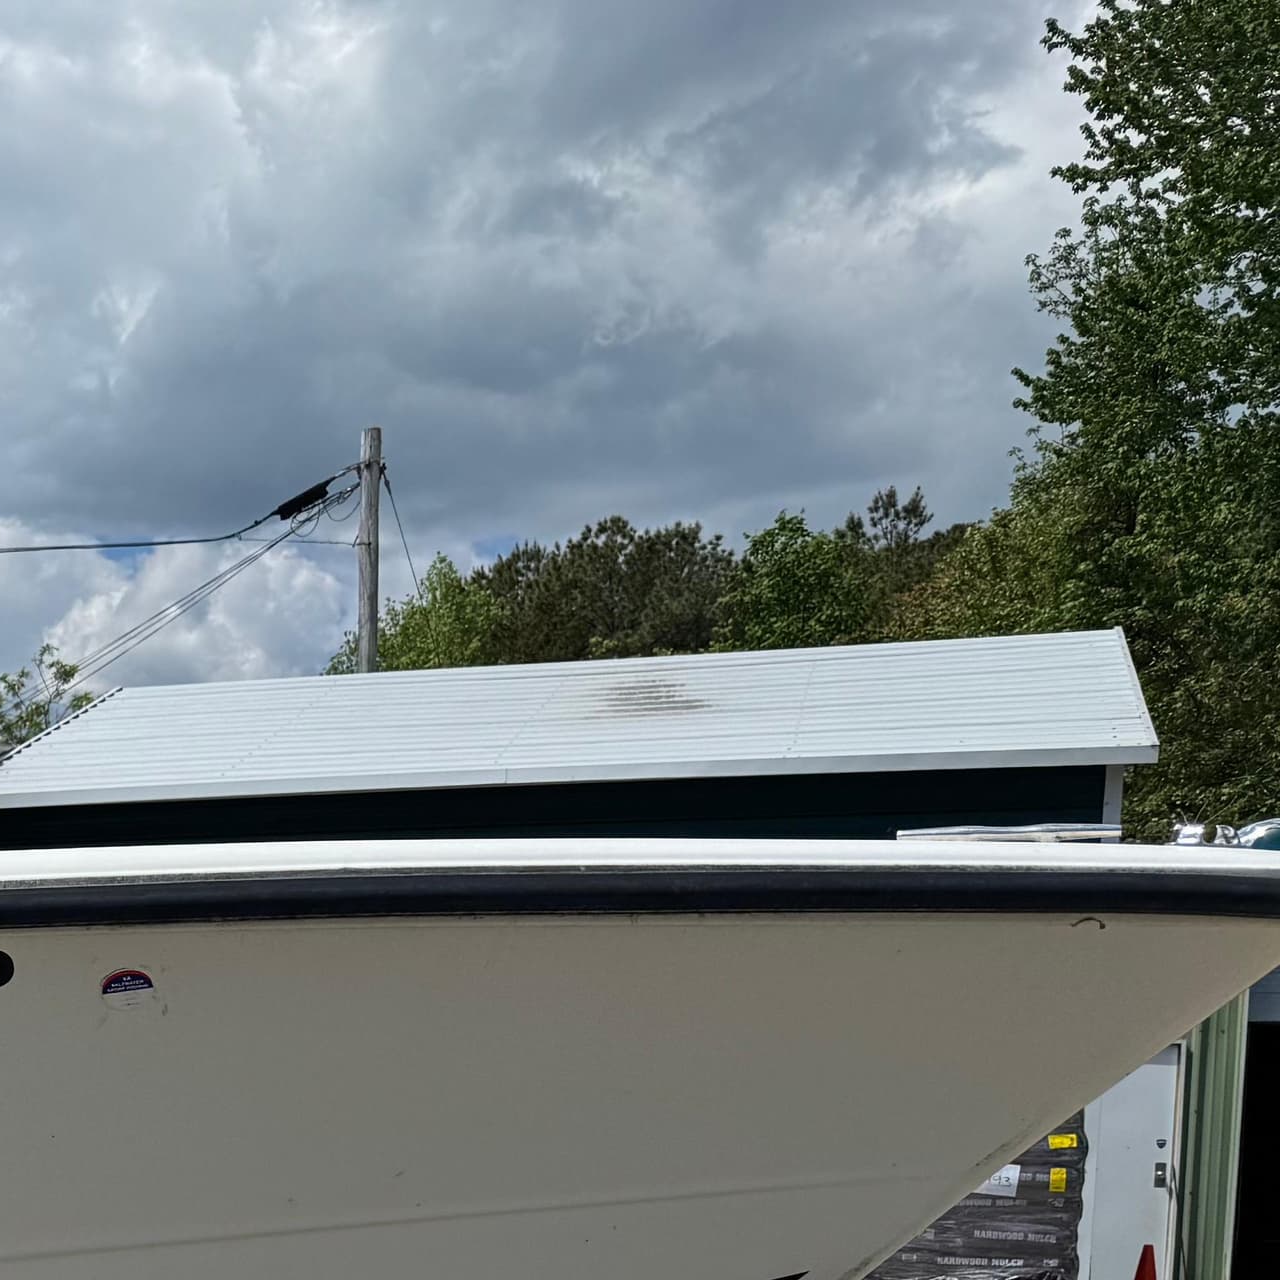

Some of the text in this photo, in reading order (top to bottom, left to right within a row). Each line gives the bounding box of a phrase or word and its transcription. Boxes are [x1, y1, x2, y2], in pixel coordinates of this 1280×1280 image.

[974, 1230, 1057, 1243] HARDWOOD MULCH
[937, 1257, 1024, 1267] HARDWOOD MULCH
